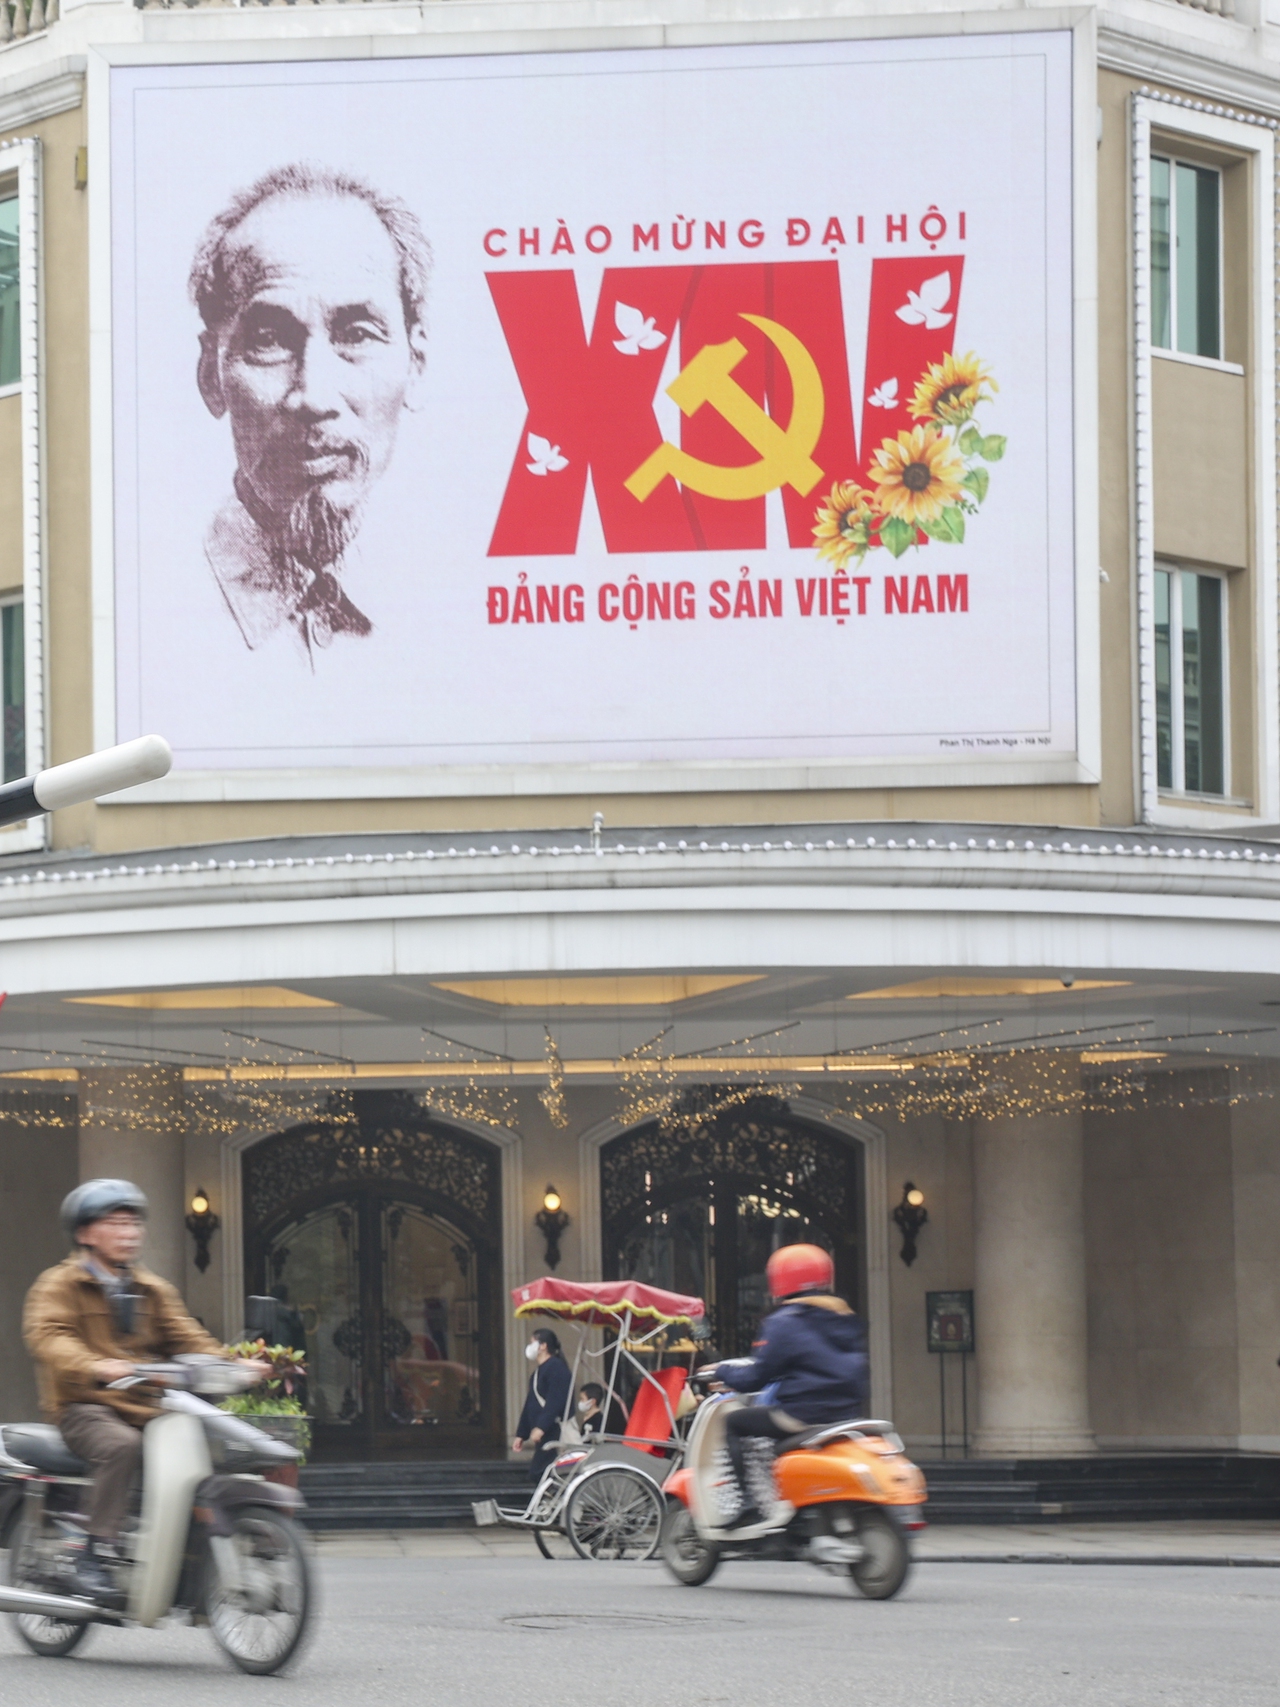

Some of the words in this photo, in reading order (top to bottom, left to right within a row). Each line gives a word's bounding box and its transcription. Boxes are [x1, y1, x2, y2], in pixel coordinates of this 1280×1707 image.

[483, 218, 613, 258] CHÀO
[632, 214, 766, 252] MỪNG
[785, 216, 865, 254] ĐẠI
[886, 204, 967, 251] HỘI
[484, 254, 966, 558] XIV
[486, 572, 586, 625] ĐẢNG
[597, 574, 697, 631] CỘNG
[708, 566, 783, 619] SẢN
[795, 569, 872, 626] VIỆT
[883, 573, 970, 614] NAM
[939, 739, 960, 747] Phan
[976, 738, 1001, 747] Thanh
